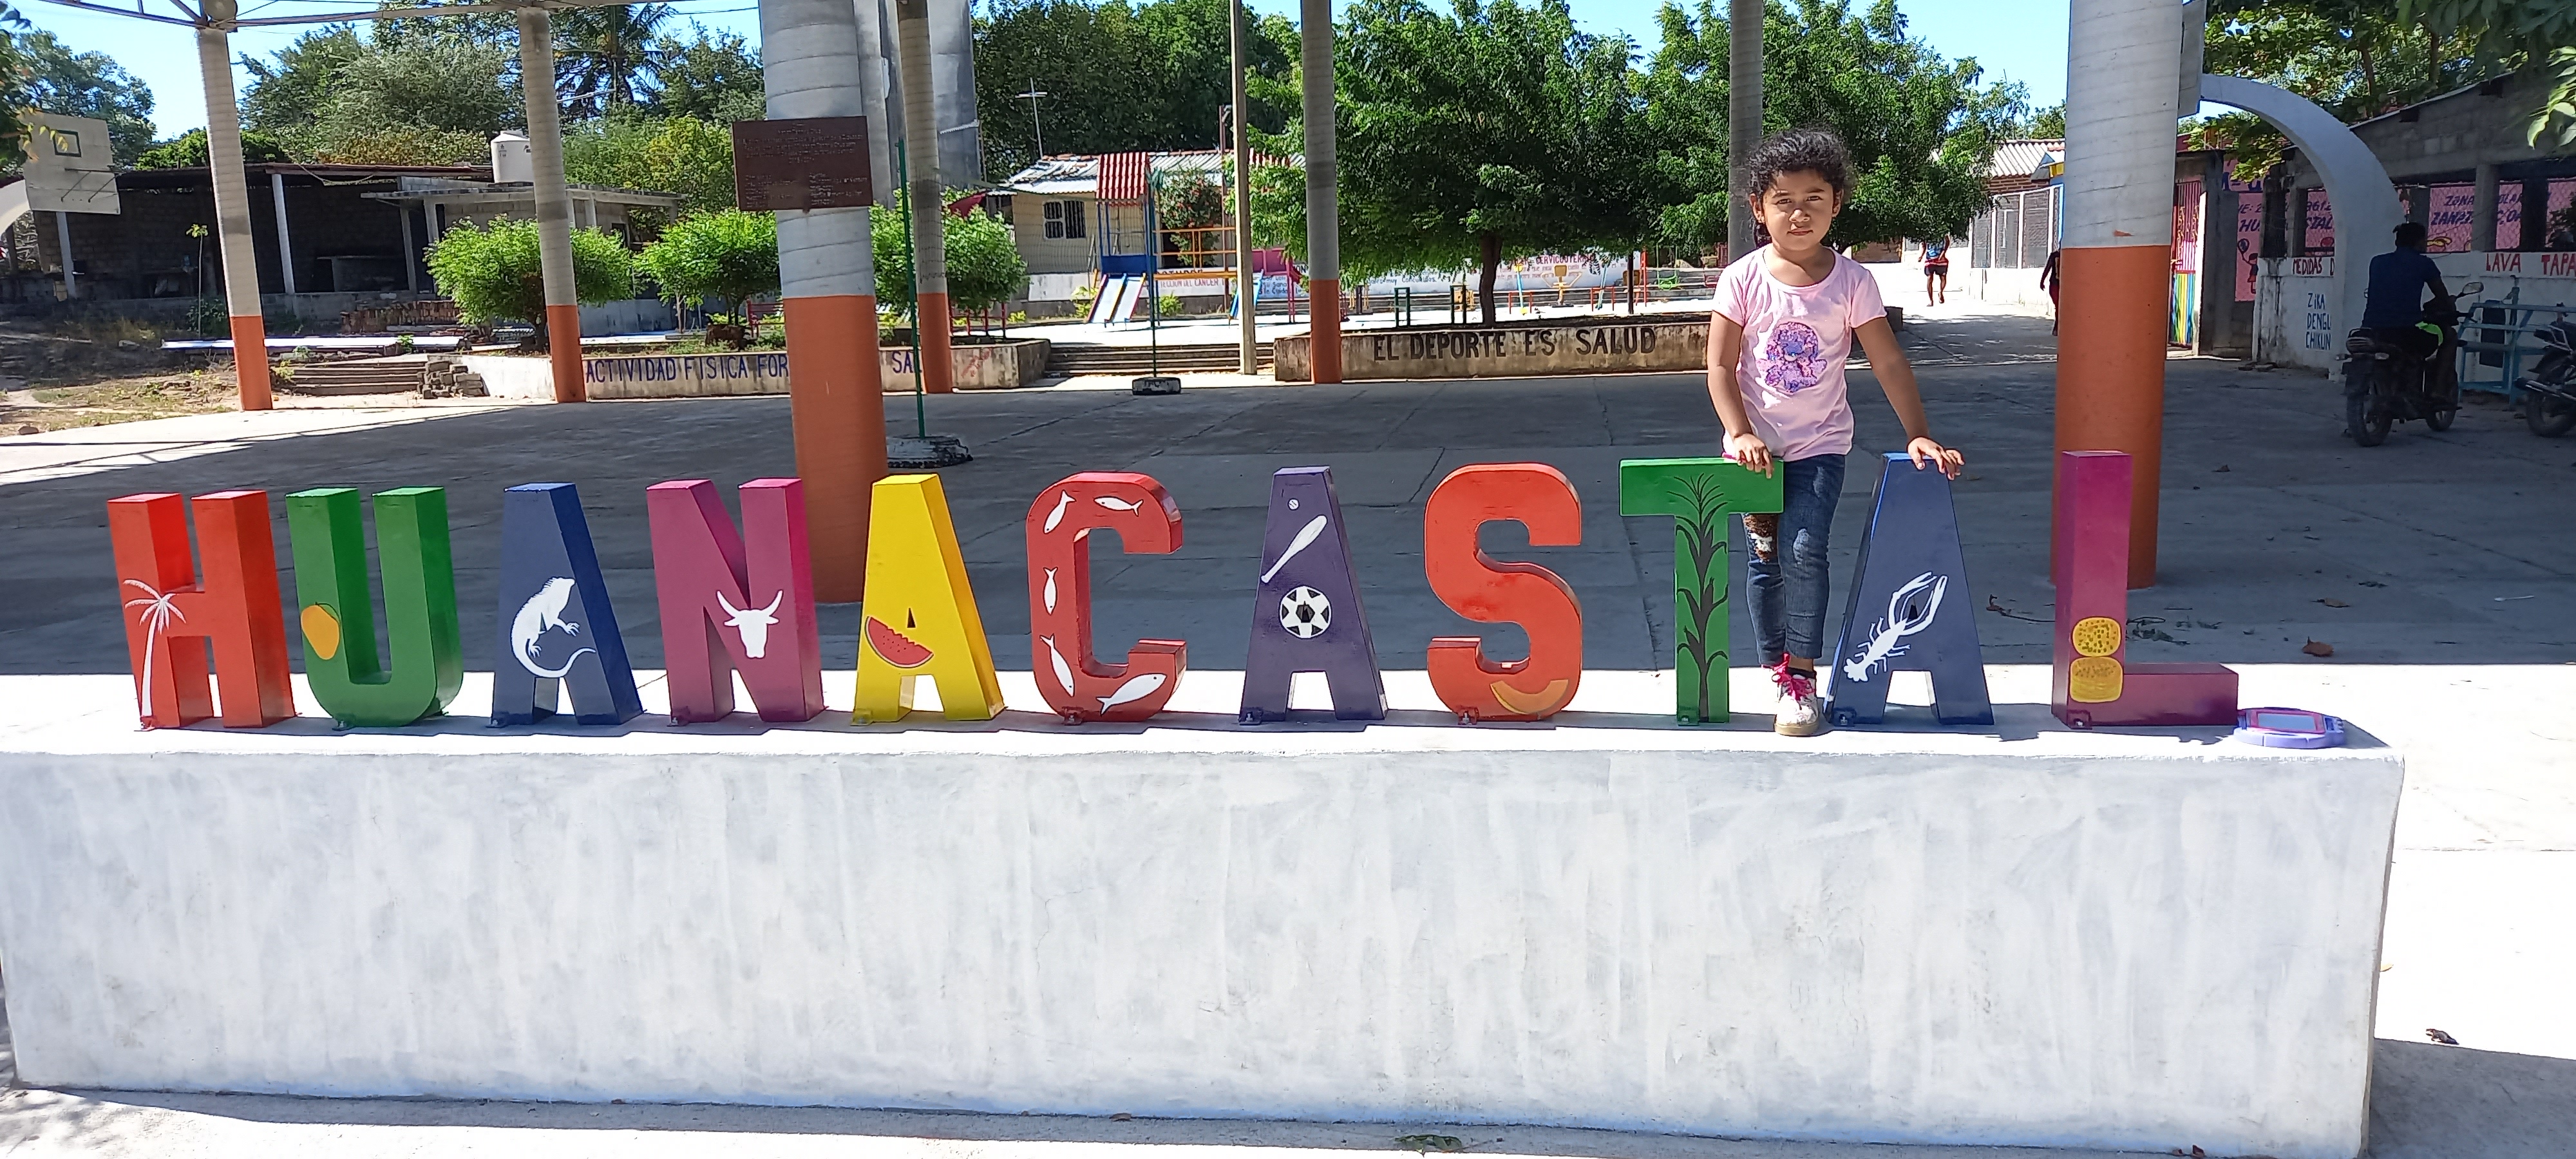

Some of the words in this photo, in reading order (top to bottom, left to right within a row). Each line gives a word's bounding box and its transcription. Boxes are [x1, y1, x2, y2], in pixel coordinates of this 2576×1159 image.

[2293, 258, 2322, 276] MEDIDAS
[2486, 253, 2521, 273] LAVA
[1374, 335, 1399, 361] EL
[1410, 331, 1506, 360] DEPORTE
[1525, 330, 1555, 357] ES
[1575, 326, 1656, 355] SALUD
[2306, 331, 2331, 350] CHIKUN
[586, 356, 676, 383] ACTIVIDAD
[685, 354, 748, 380] FISICA
[757, 353, 789, 378] FOR
[107, 449, 2239, 733] HUANACASTAL
